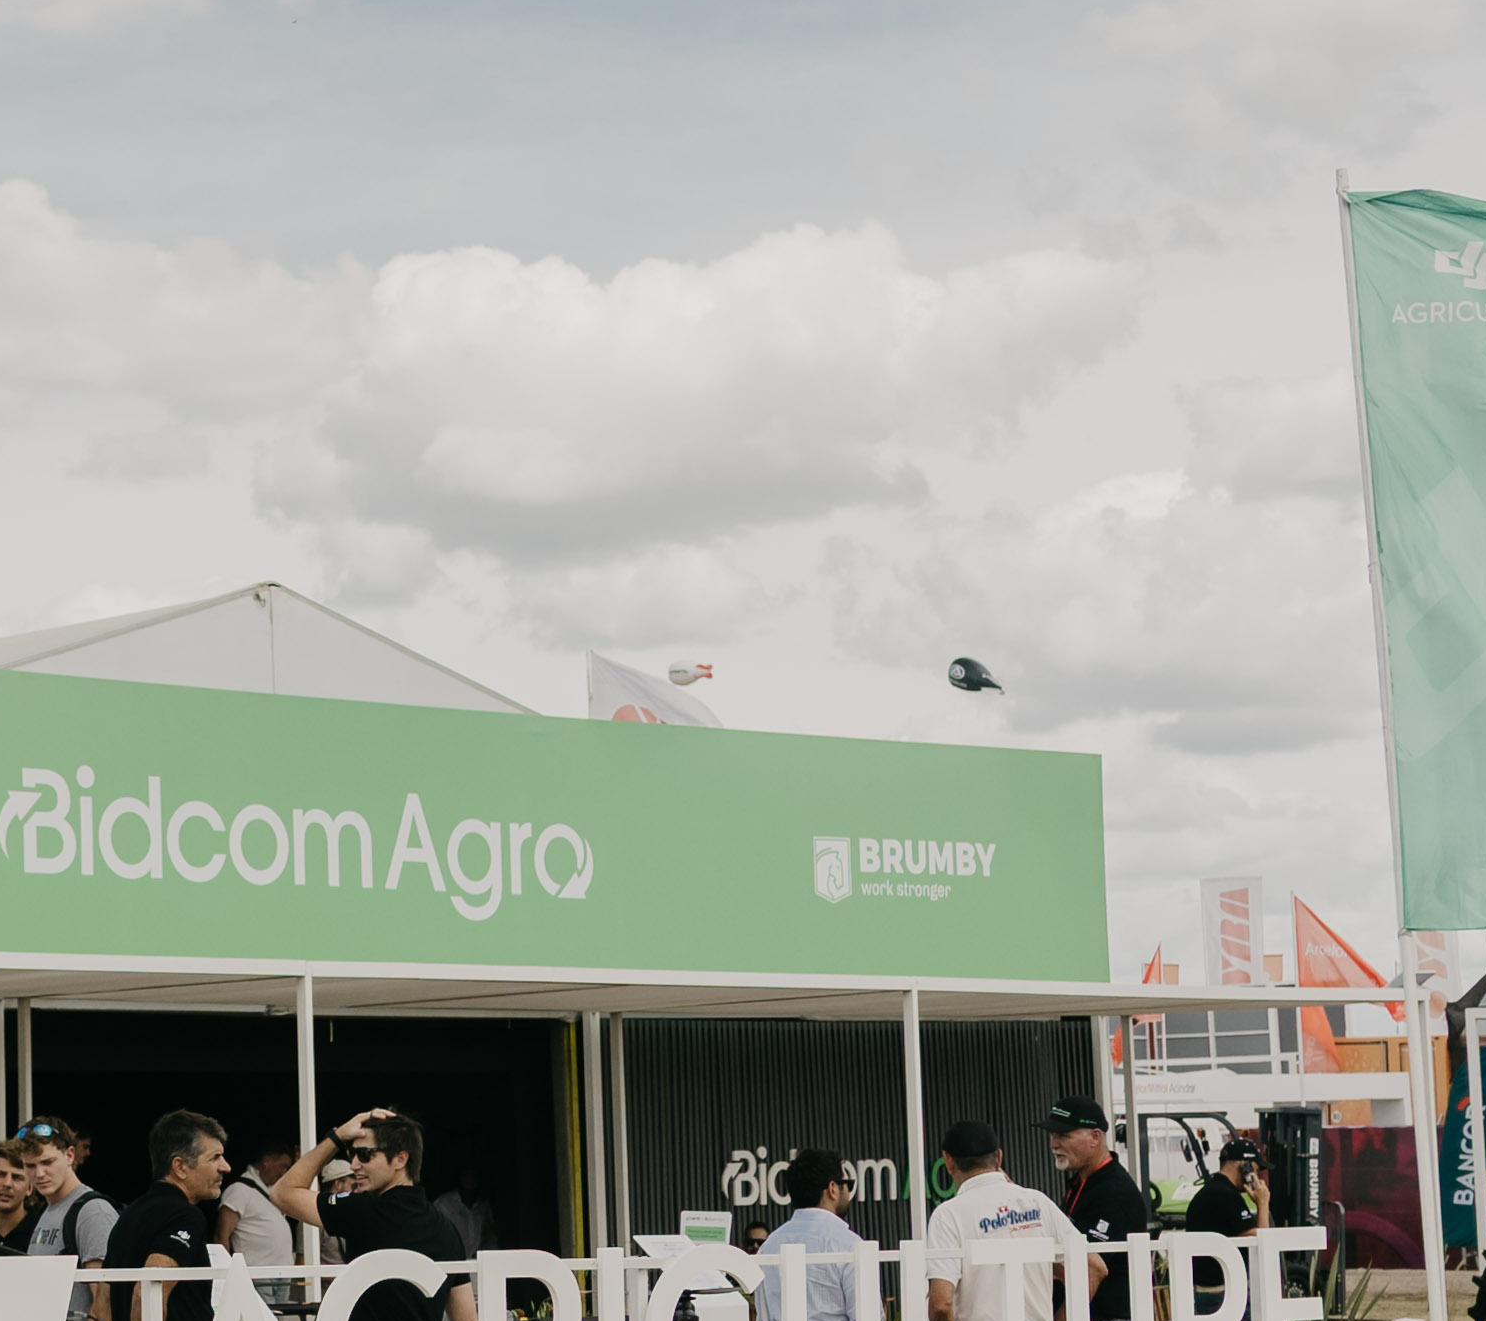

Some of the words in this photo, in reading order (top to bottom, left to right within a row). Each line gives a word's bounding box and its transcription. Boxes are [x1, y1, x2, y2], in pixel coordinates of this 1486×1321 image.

[859, 838, 996, 877] BRUMBY
[861, 880, 894, 896] work
[896, 881, 951, 901] stronger
[1309, 1158, 1320, 1219] BRUMBY
